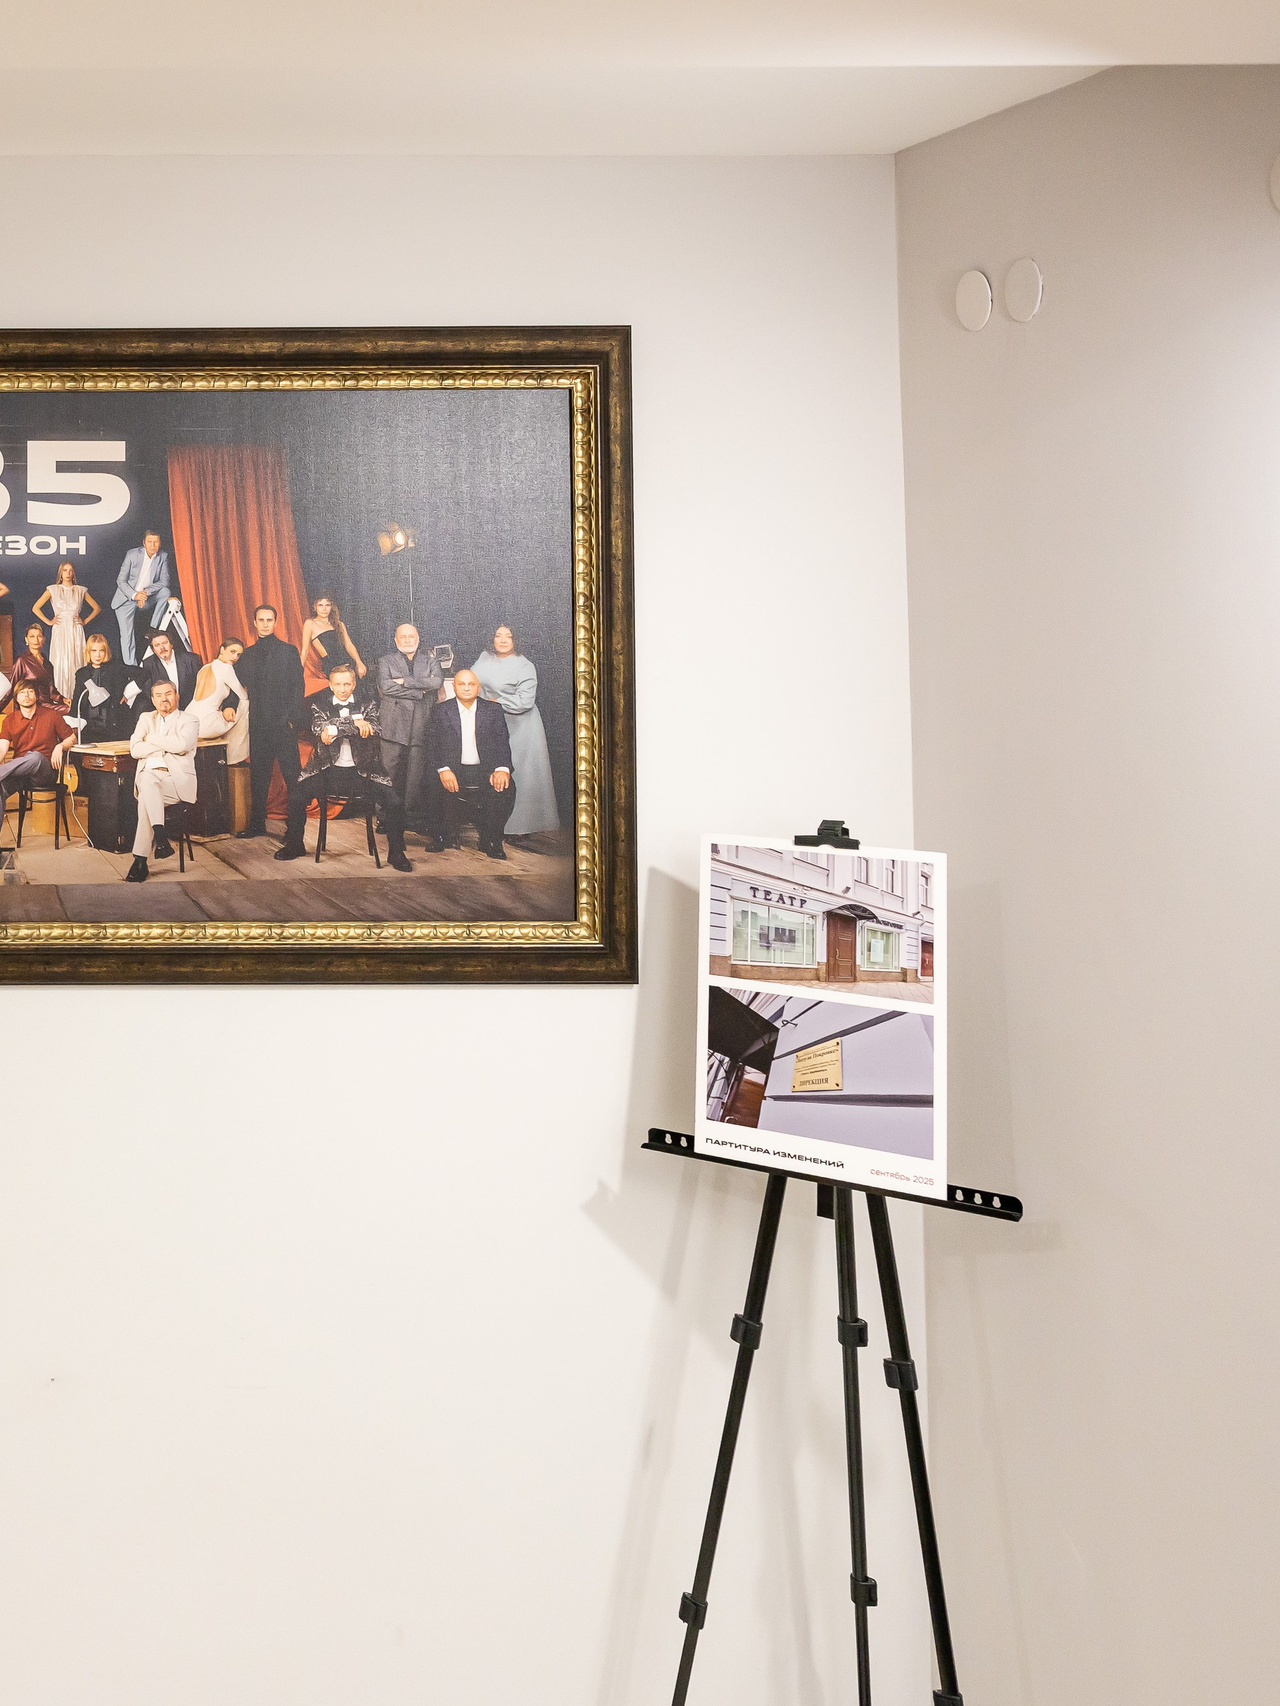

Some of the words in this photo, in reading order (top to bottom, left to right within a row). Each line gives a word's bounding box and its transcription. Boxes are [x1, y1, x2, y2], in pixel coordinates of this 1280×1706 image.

[749, 886, 808, 908] ТЕАТР
[705, 1137, 771, 1155] ПАРТИТУРА
[772, 1149, 845, 1169] ИЗМЕНЕНИЙ
[870, 1168, 911, 1182] сентябрь
[912, 1175, 935, 1186] 2025
